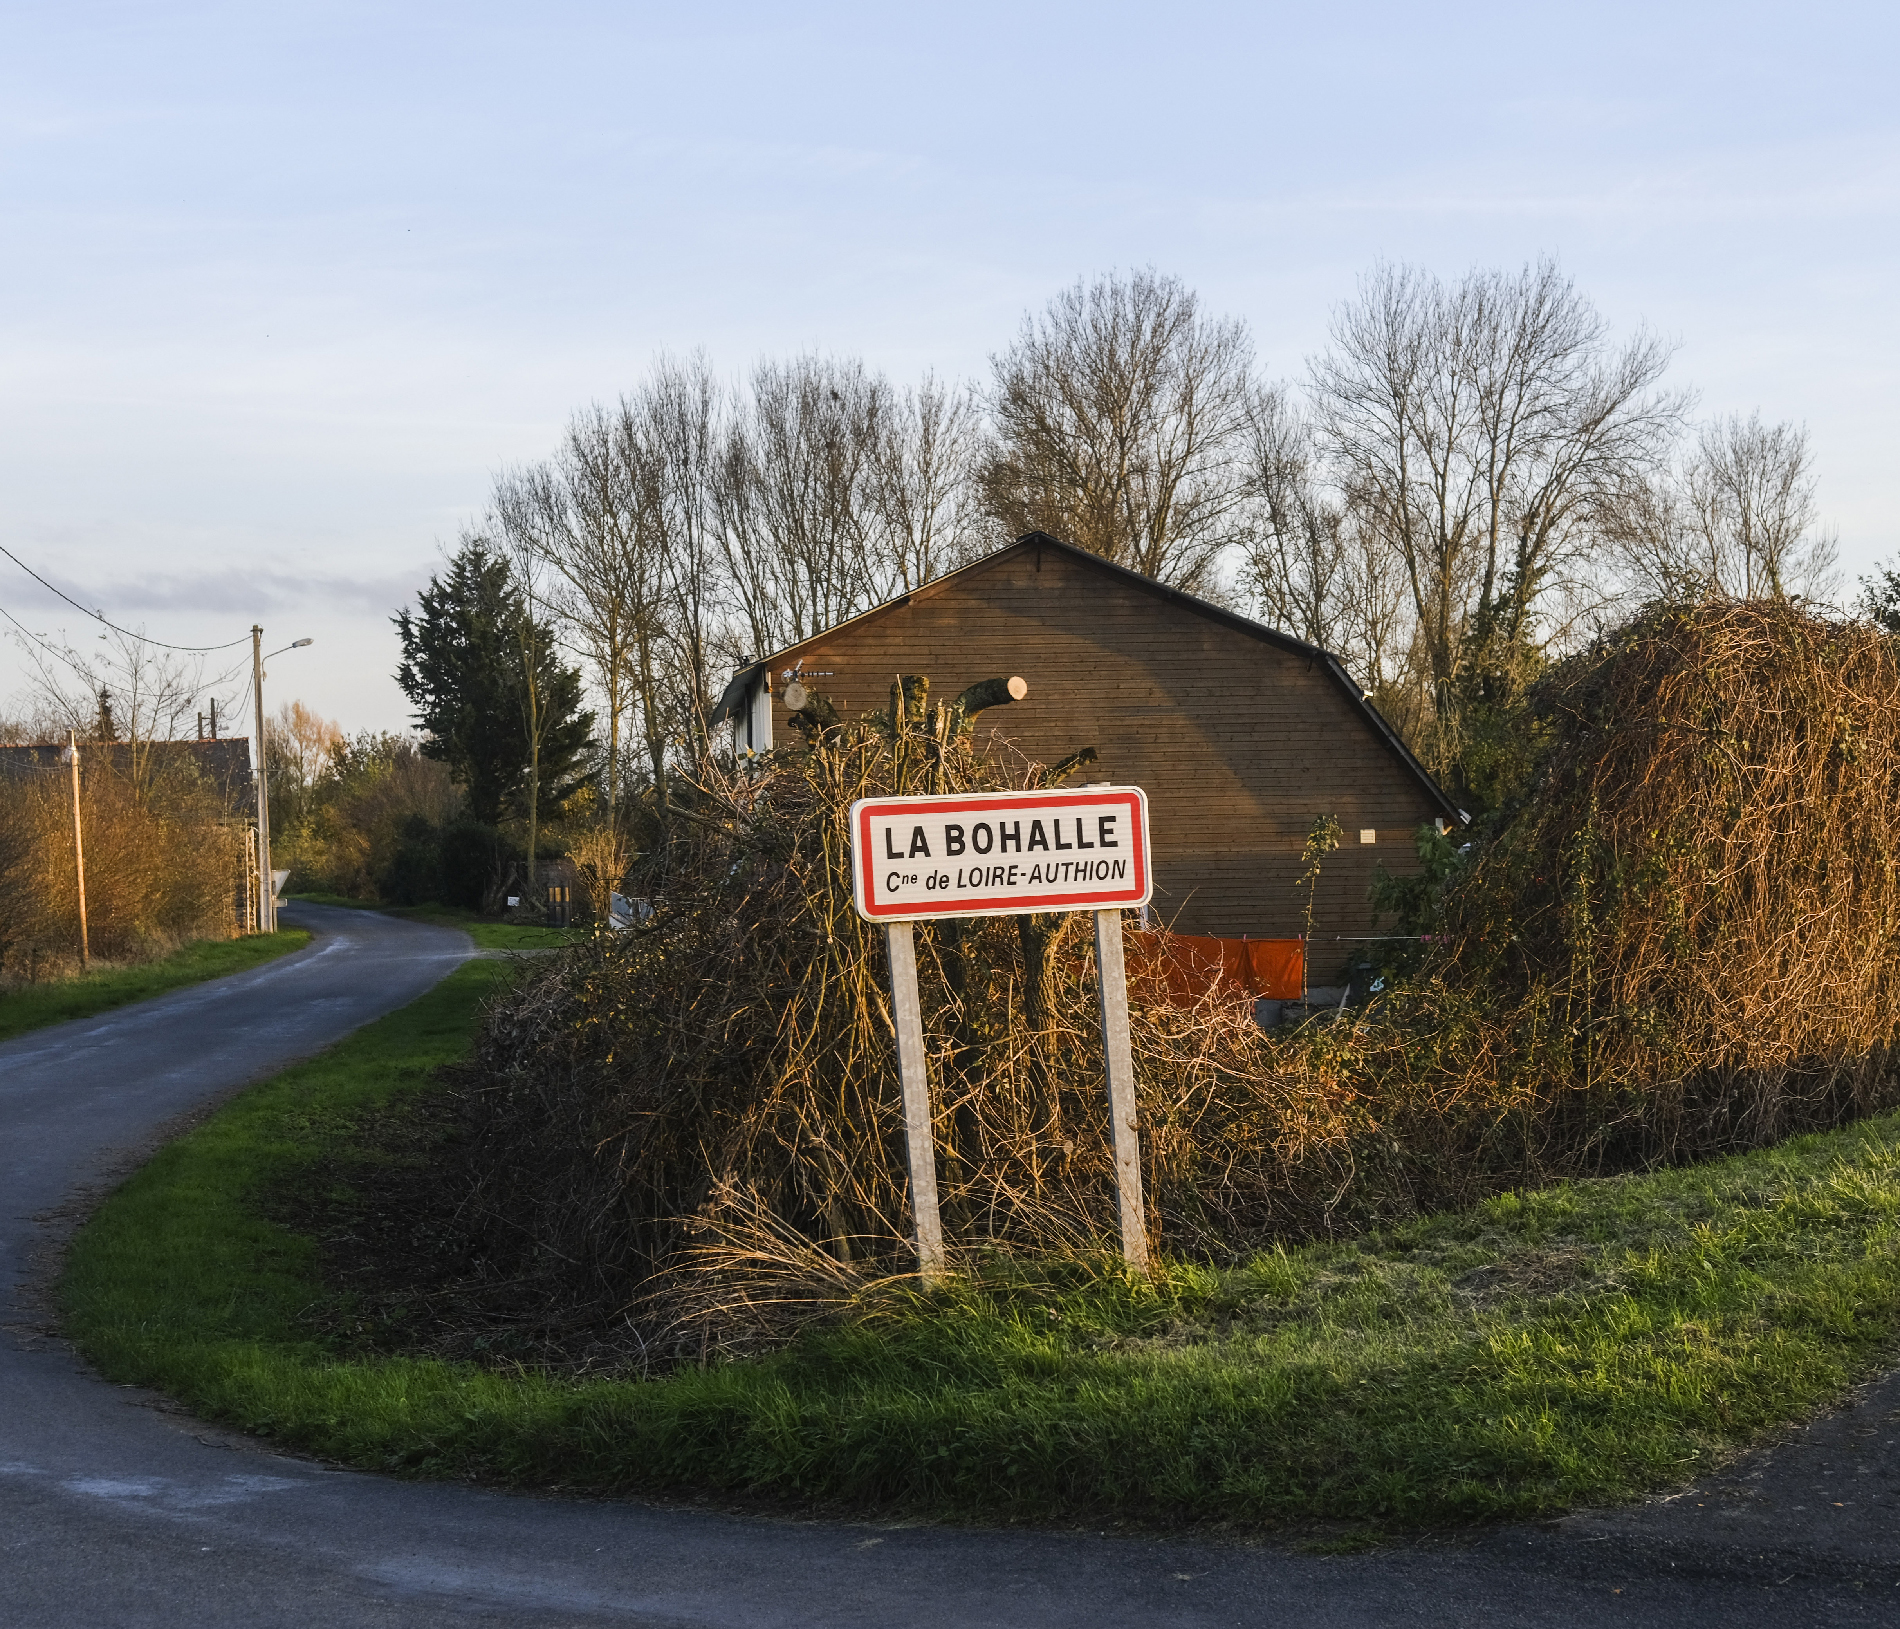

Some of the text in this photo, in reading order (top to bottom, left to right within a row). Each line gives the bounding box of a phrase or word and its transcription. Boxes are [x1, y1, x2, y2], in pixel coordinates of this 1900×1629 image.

[885, 815, 1118, 859] LA BOHALLE
[886, 859, 1126, 892] Cne de LOIRE-AUTHION
